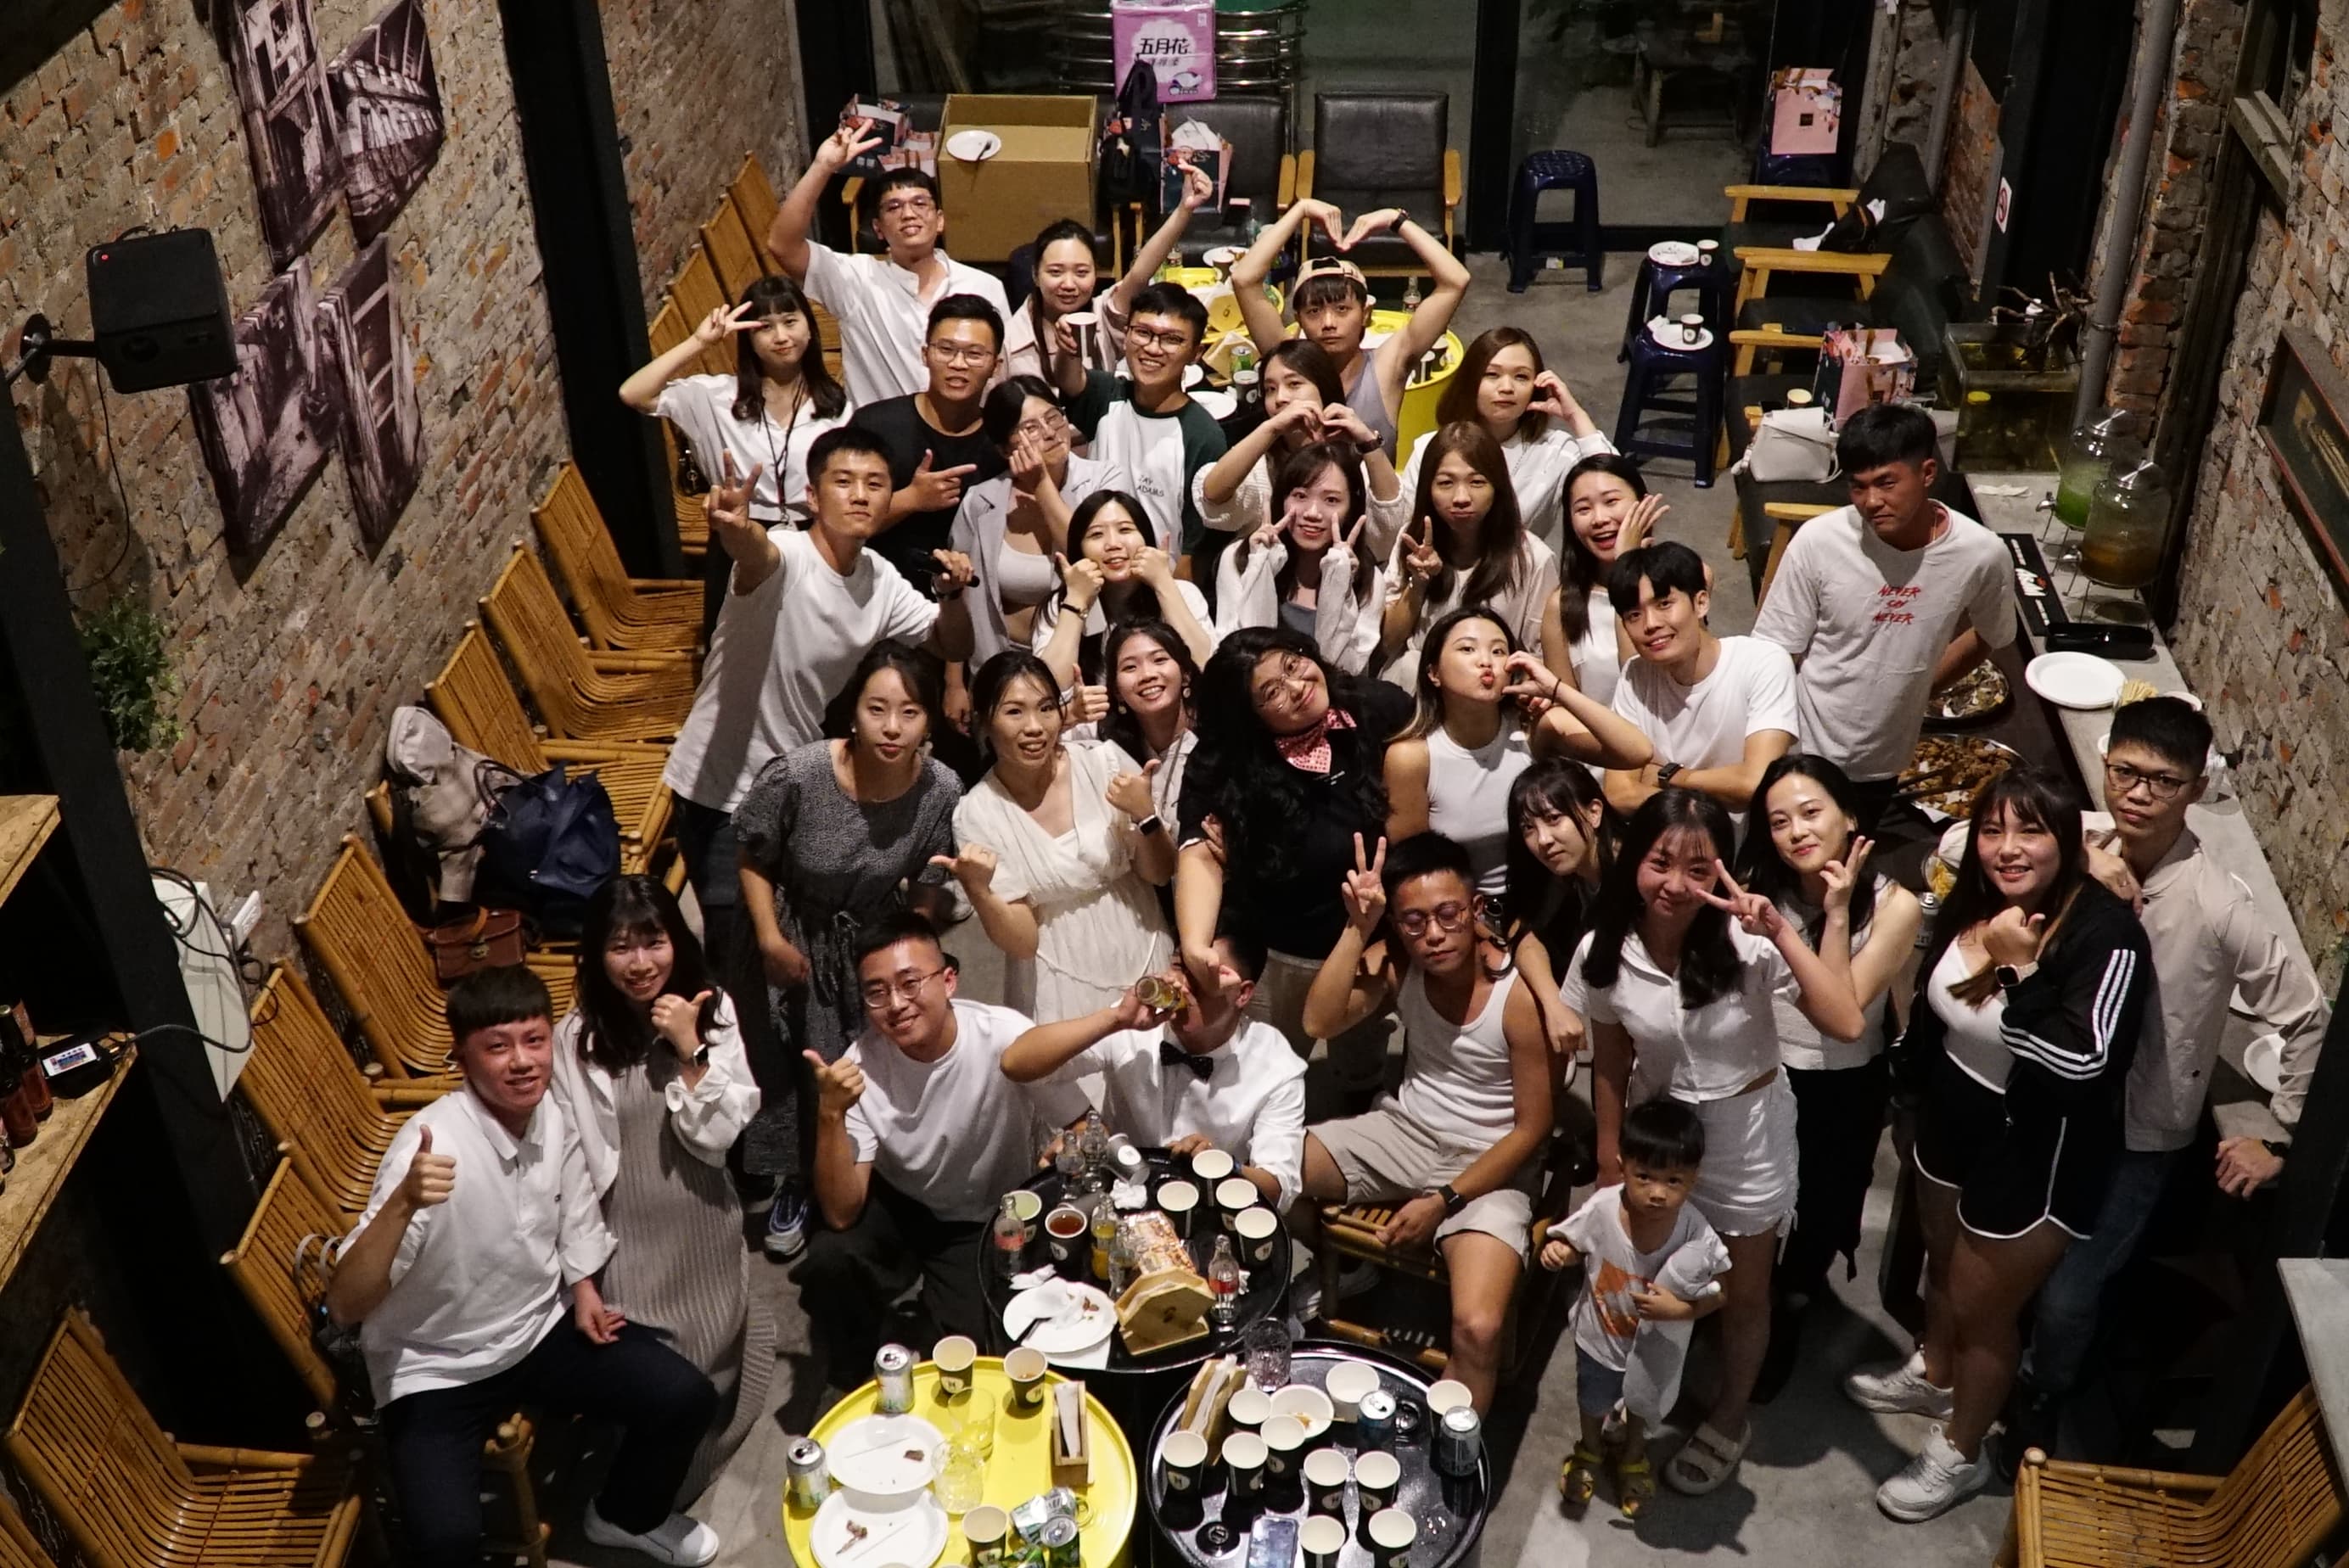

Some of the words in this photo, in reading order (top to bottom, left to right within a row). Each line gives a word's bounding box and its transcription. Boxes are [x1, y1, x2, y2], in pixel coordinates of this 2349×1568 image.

[1140, 38, 1190, 54] 五月花
[1877, 584, 1921, 598] NEVER
[1872, 611, 1915, 624] NEVER
